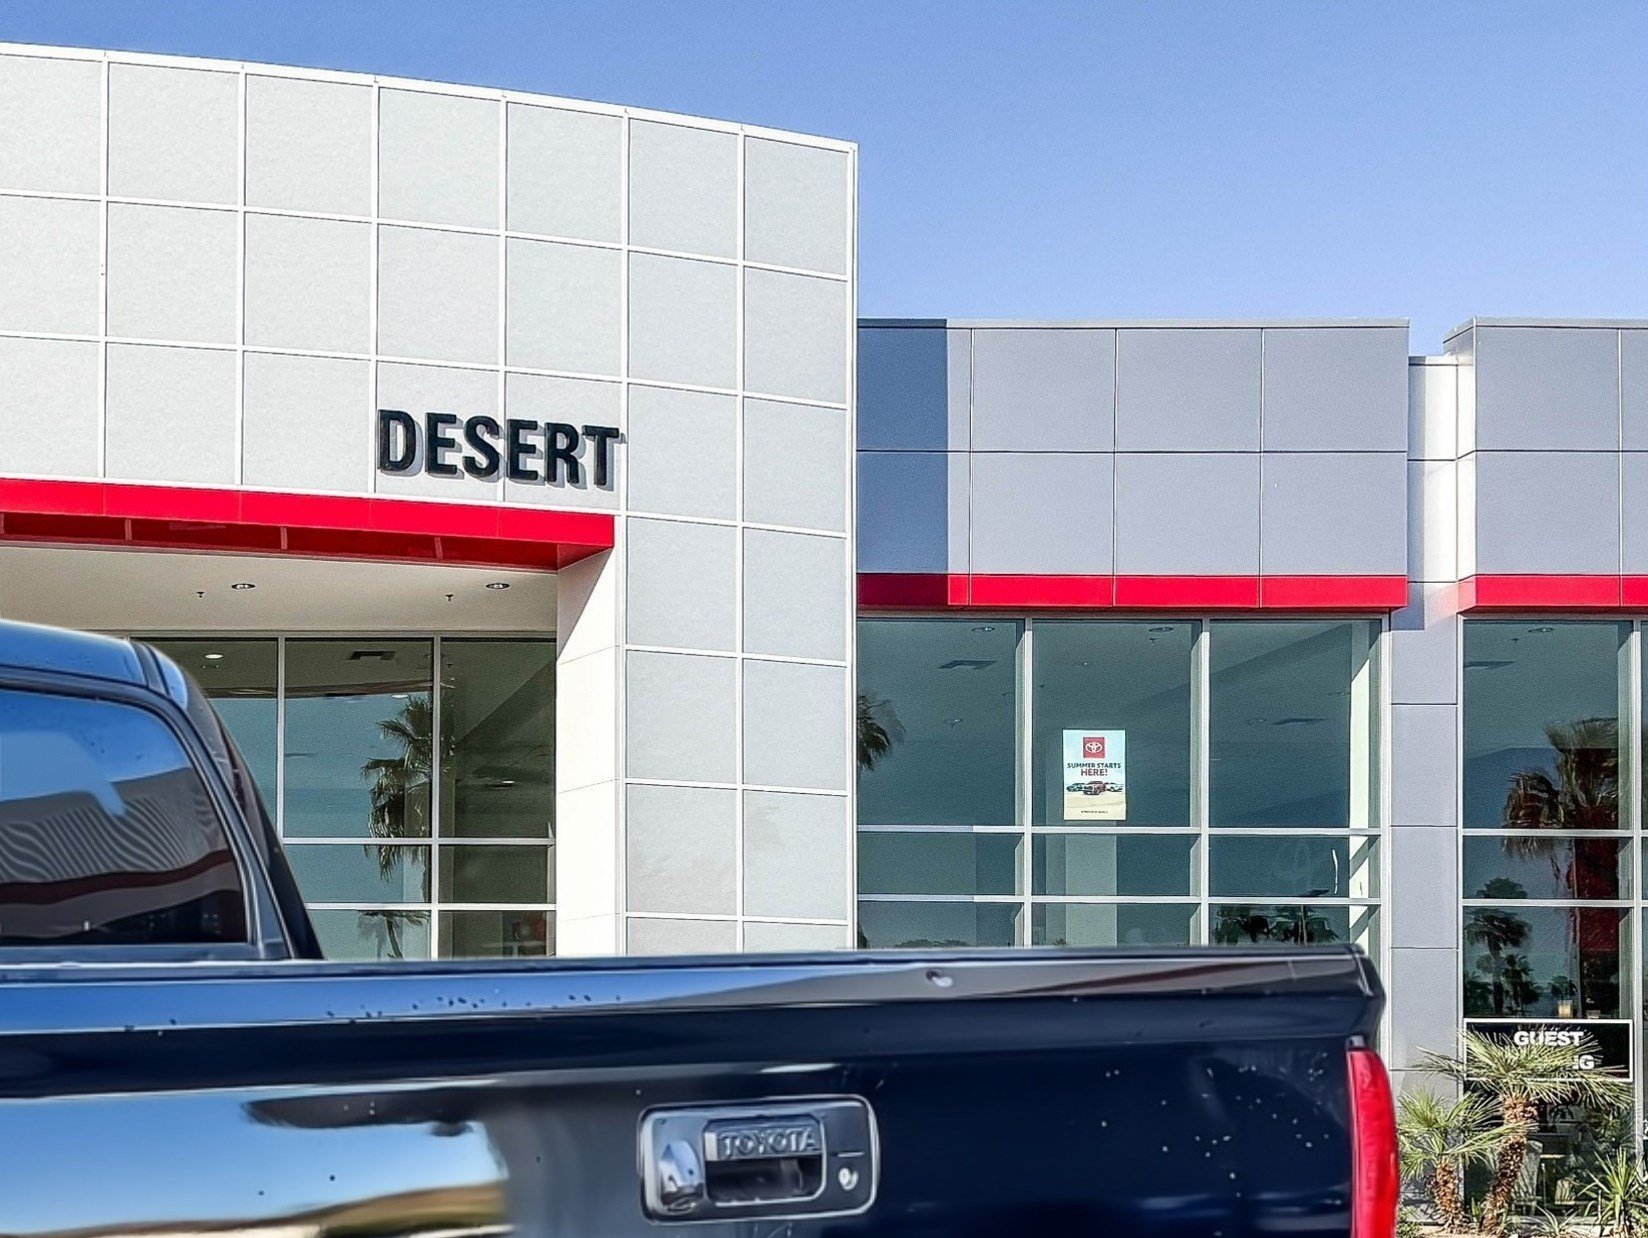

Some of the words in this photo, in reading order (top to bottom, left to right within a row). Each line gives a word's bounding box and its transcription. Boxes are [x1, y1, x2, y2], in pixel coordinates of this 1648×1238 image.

[376, 408, 620, 487] DESERT
[1080, 768, 1108, 776] HERE!
[1513, 1030, 1584, 1047] GUEST
[719, 1127, 818, 1157] TOYOTA
